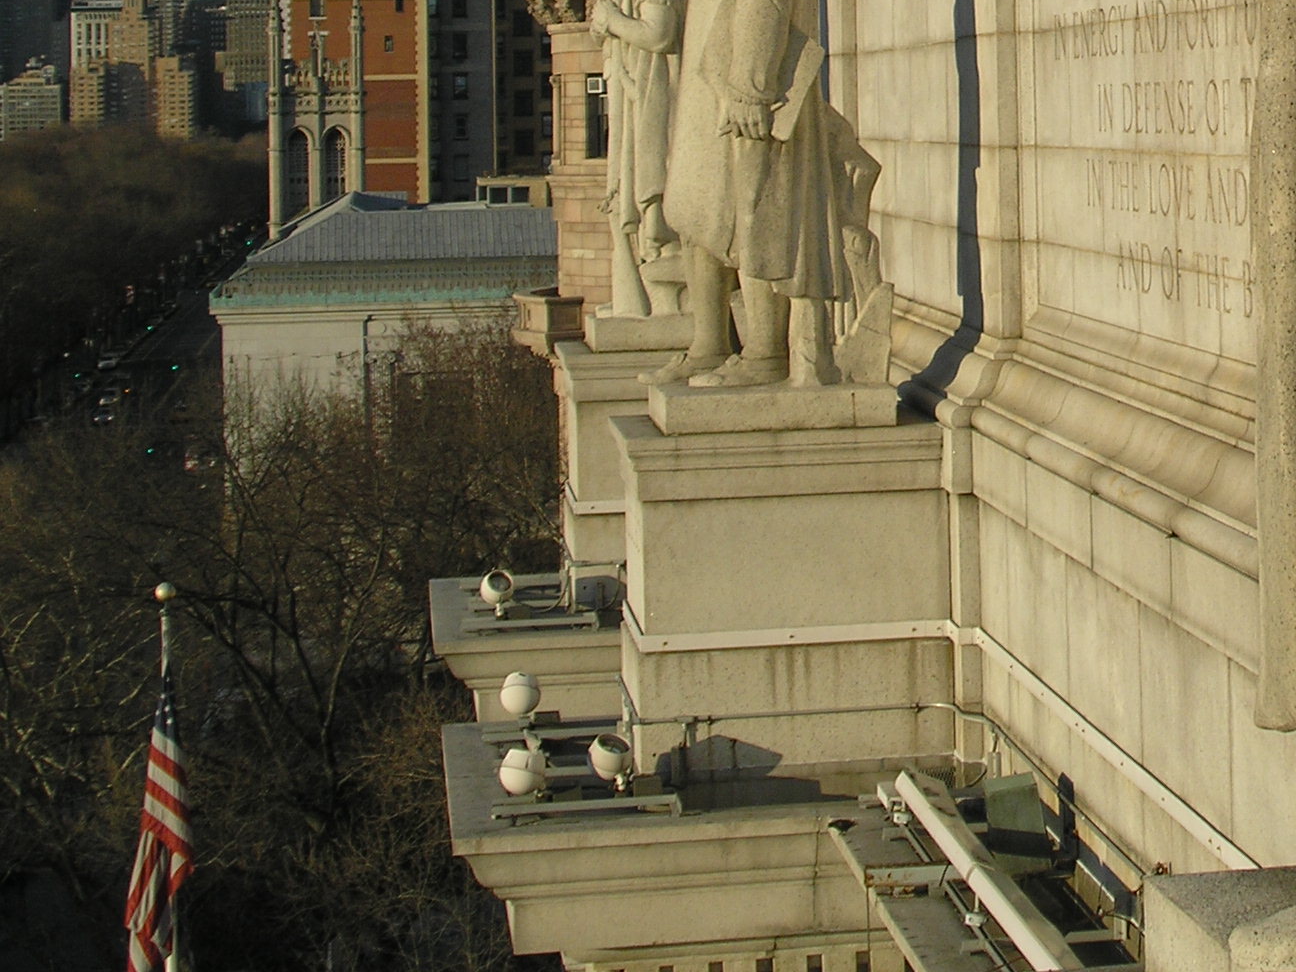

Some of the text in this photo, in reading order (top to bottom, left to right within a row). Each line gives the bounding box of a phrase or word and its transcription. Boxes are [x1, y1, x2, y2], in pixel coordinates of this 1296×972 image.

[1054, 13, 1068, 60] IN
[1072, 4, 1128, 60] ENERGY
[1134, 0, 1169, 55] AND
[1098, 83, 1114, 134] IN
[1122, 79, 1196, 136] DEFENSE
[1205, 79, 1231, 137] OF
[1086, 158, 1249, 227] IN THE LOVE AND
[1116, 240, 1152, 295] AND
[1160, 245, 1183, 303] OF
[1194, 250, 1231, 314] THE
